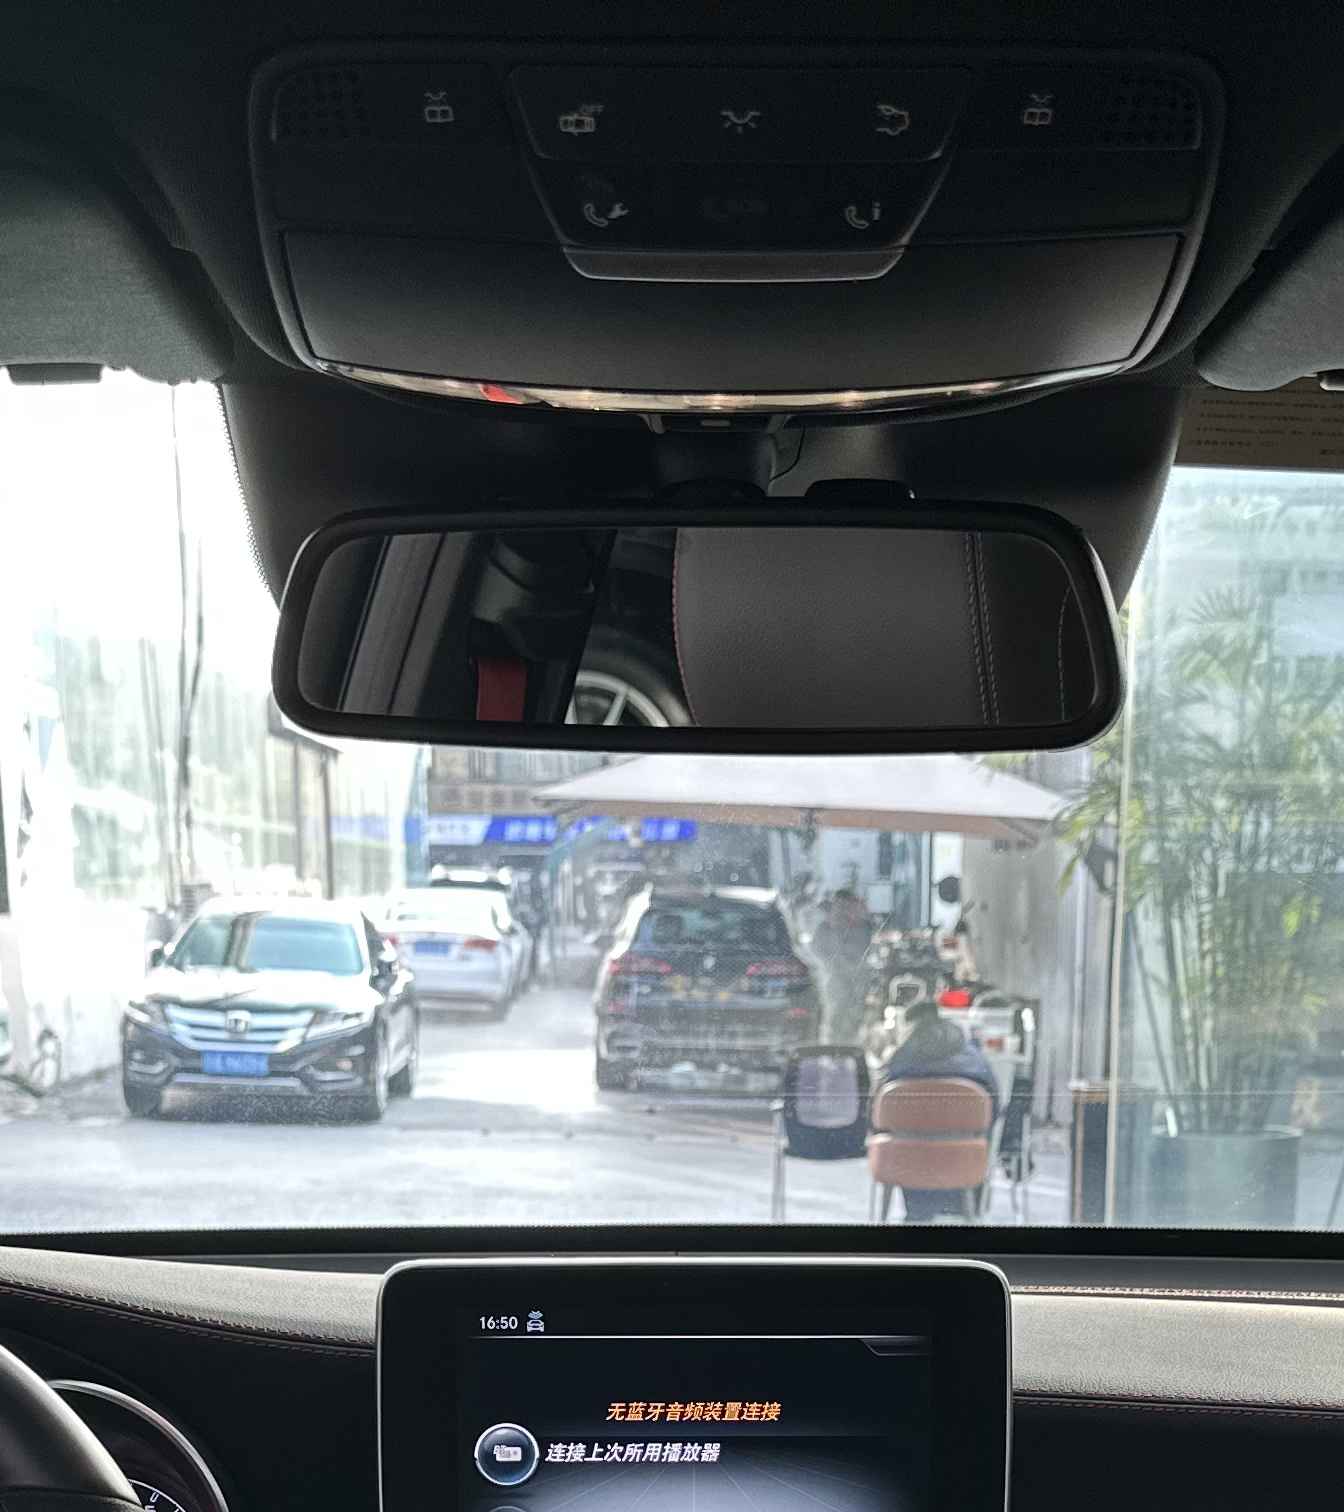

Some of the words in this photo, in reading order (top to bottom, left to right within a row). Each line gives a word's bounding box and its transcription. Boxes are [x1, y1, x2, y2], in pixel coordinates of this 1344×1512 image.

[580, 104, 604, 116] OFF
[479, 1316, 518, 1330] 16:50
[606, 1401, 781, 1422] 无蓝牙音频装置连接
[545, 1442, 721, 1463] 连接上次所用播放器
